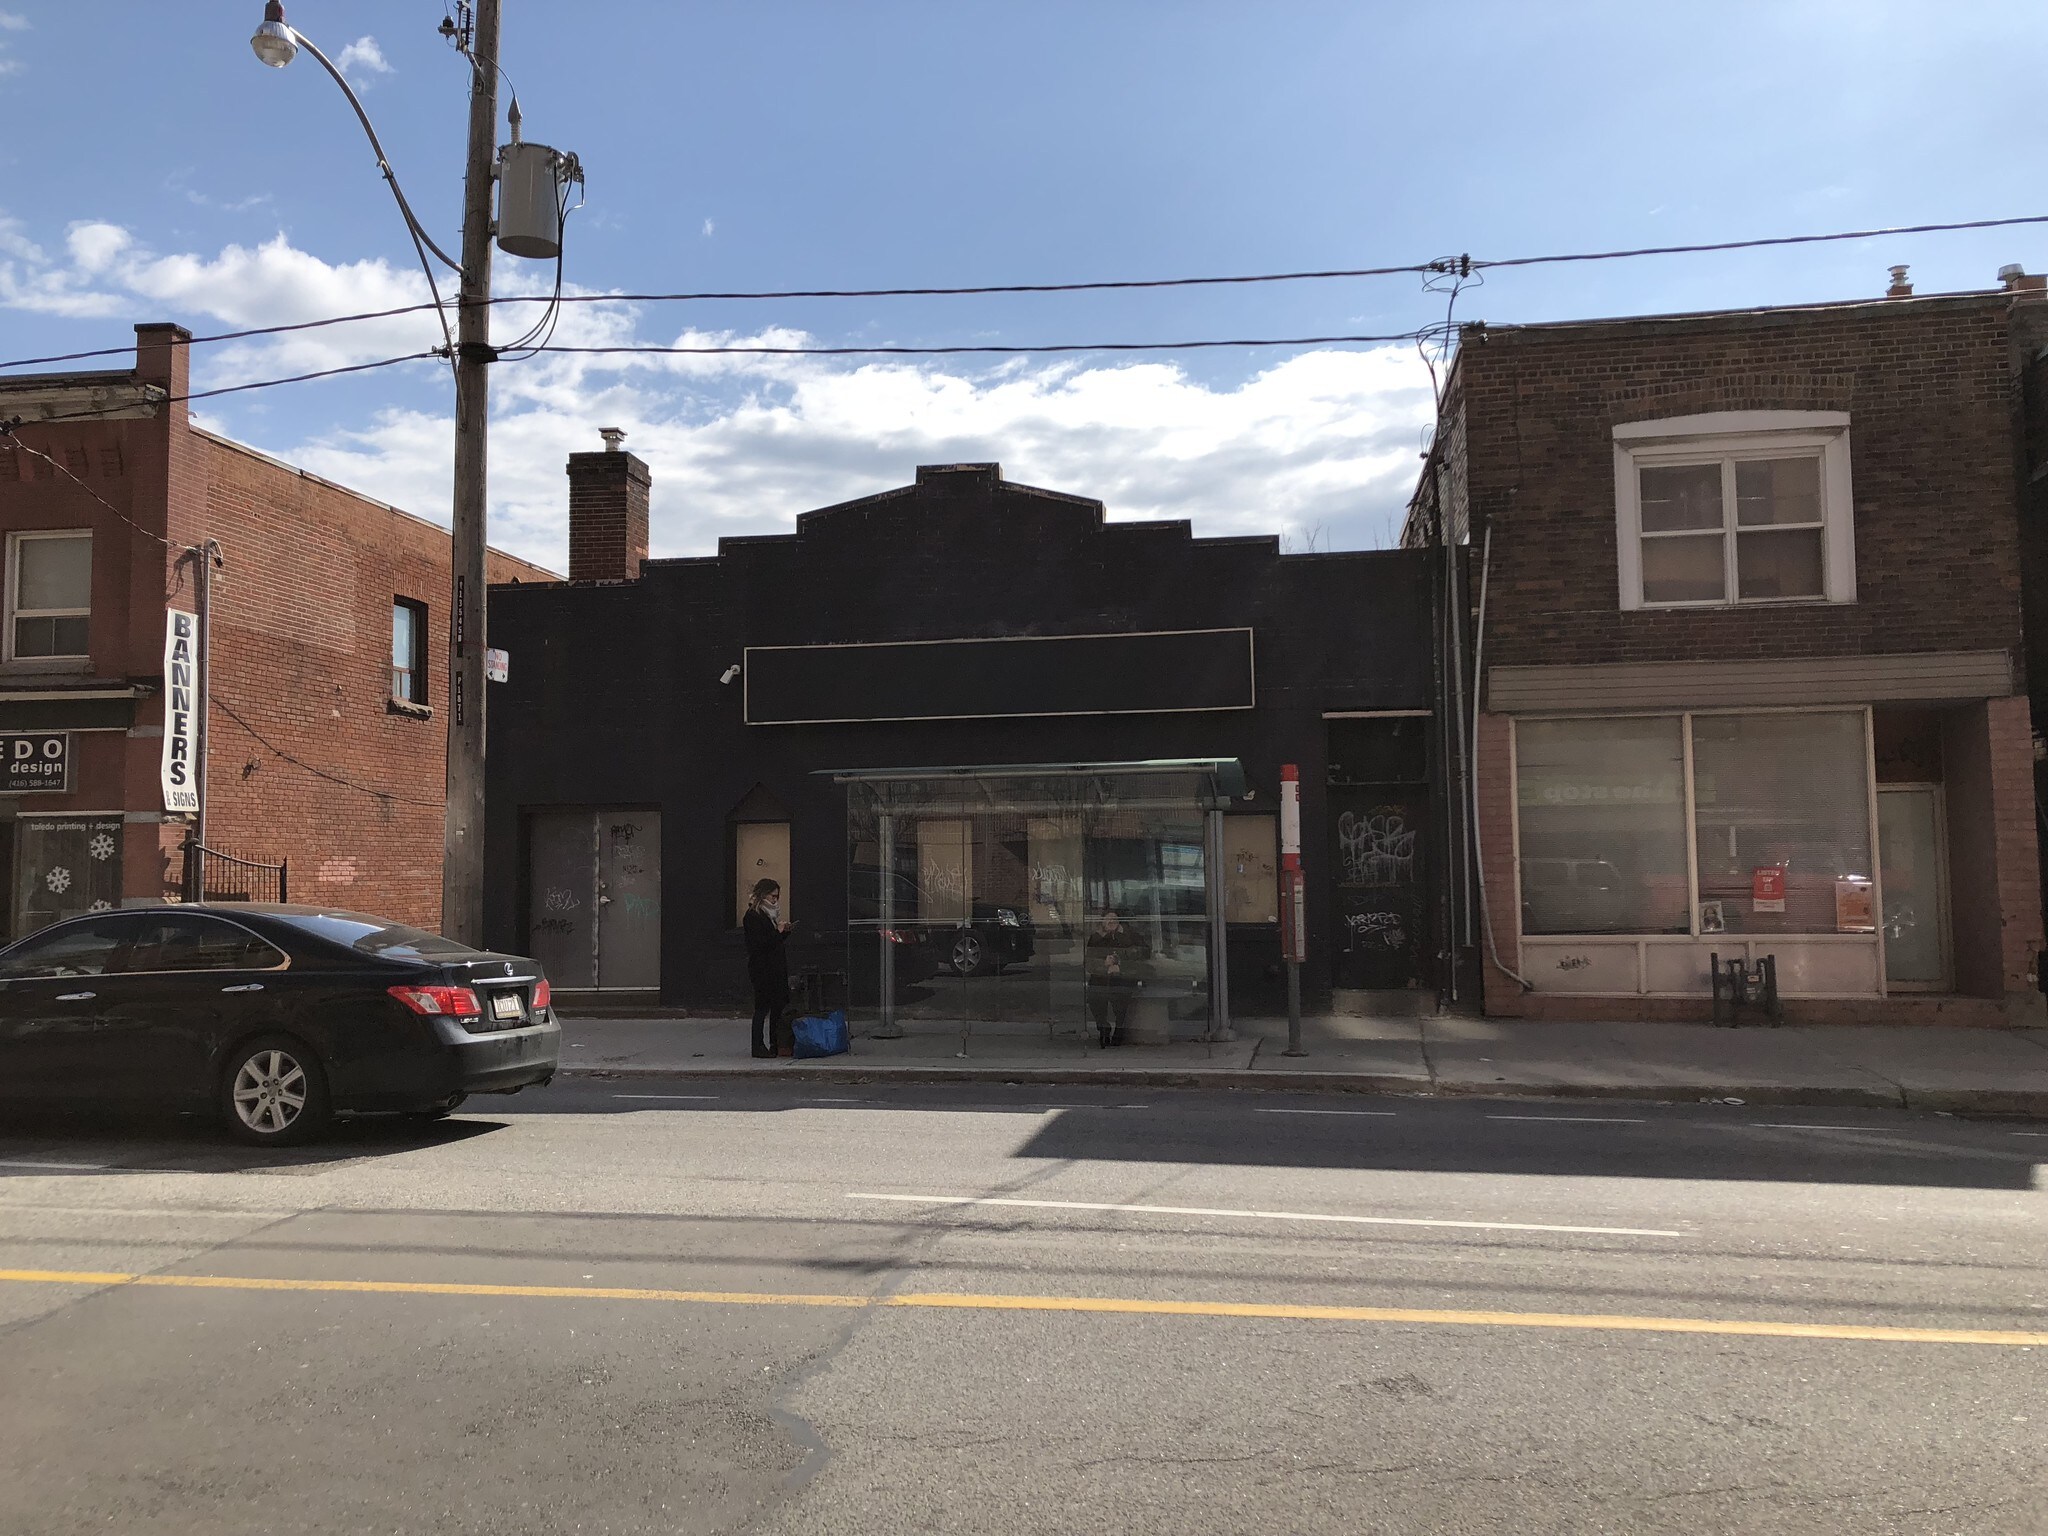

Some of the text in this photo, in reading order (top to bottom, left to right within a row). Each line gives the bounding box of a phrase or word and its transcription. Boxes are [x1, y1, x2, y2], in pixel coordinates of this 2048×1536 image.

[170, 613, 191, 786] BANNERS
[0, 739, 63, 759] DO
[10, 760, 62, 776] design
[9, 779, 28, 788] (416)
[172, 791, 197, 808] SIGNS
[31, 822, 55, 831] toledo
[56, 821, 86, 832] printing
[95, 820, 121, 832] design
